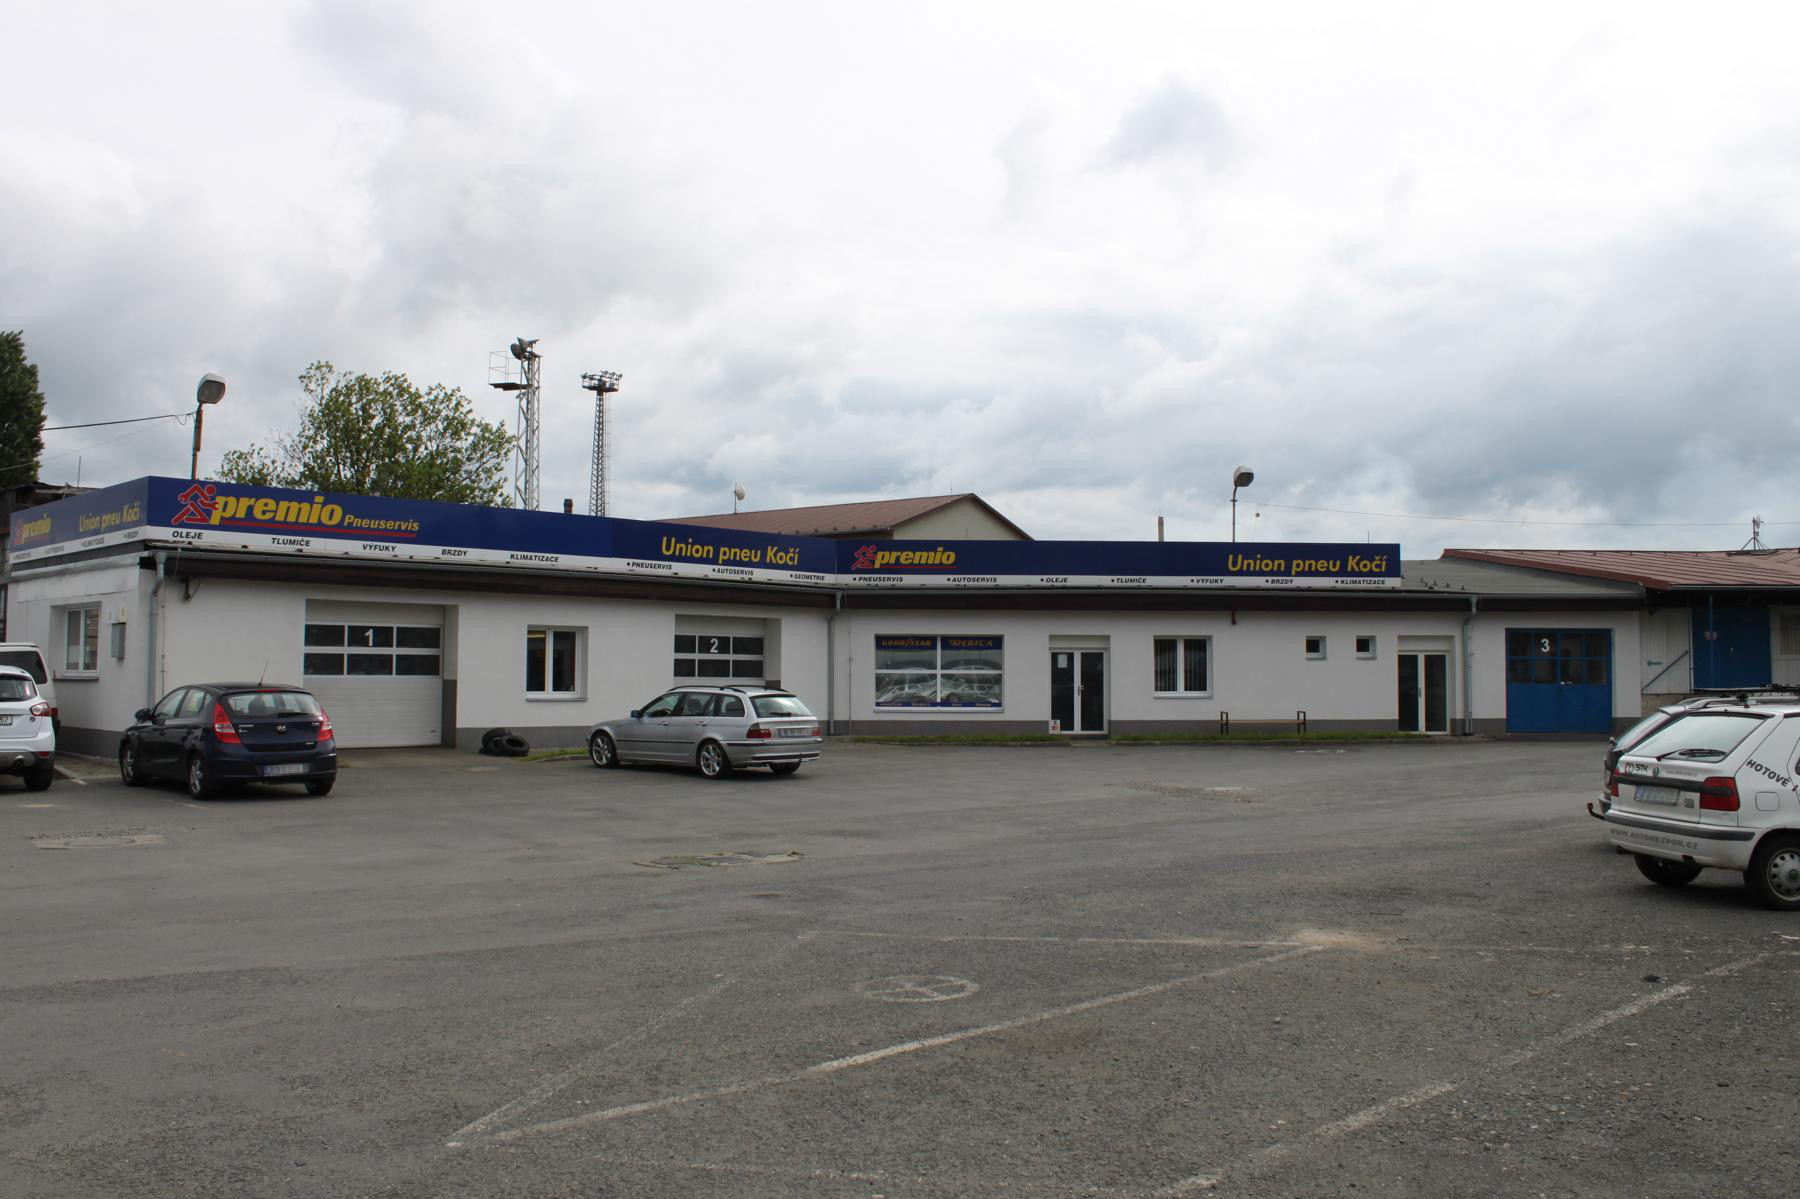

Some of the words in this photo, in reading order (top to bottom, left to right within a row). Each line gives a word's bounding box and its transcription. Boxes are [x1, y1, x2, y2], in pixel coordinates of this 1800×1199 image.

[209, 495, 343, 526] premio
[21, 512, 51, 544] premio
[79, 512, 100, 532] Union
[102, 512, 120, 531] pneu
[343, 514, 420, 531] Pneuservis
[172, 530, 204, 540] OLEJE
[271, 537, 311, 547] TLUMIČE
[441, 548, 468, 557] BRZDY
[510, 553, 559, 563] KLIMATIZACE
[631, 561, 672, 571] PNEUSERVIS
[716, 567, 754, 576] AUTOSERVIS
[793, 573, 825, 582] GEOMETRIE
[661, 535, 714, 559] Union
[718, 549, 761, 564] pneu
[766, 546, 800, 566] Kočí
[874, 547, 956, 569] premio
[1227, 554, 1285, 572] Union
[1291, 559, 1341, 576] pneu
[1347, 555, 1387, 573] Kočí
[364, 628, 374, 647] 1
[710, 638, 719, 653] 2
[1541, 638, 1550, 653] 3
[1636, 764, 1648, 773] STK
[1746, 759, 1791, 787] HOTOVÉ
